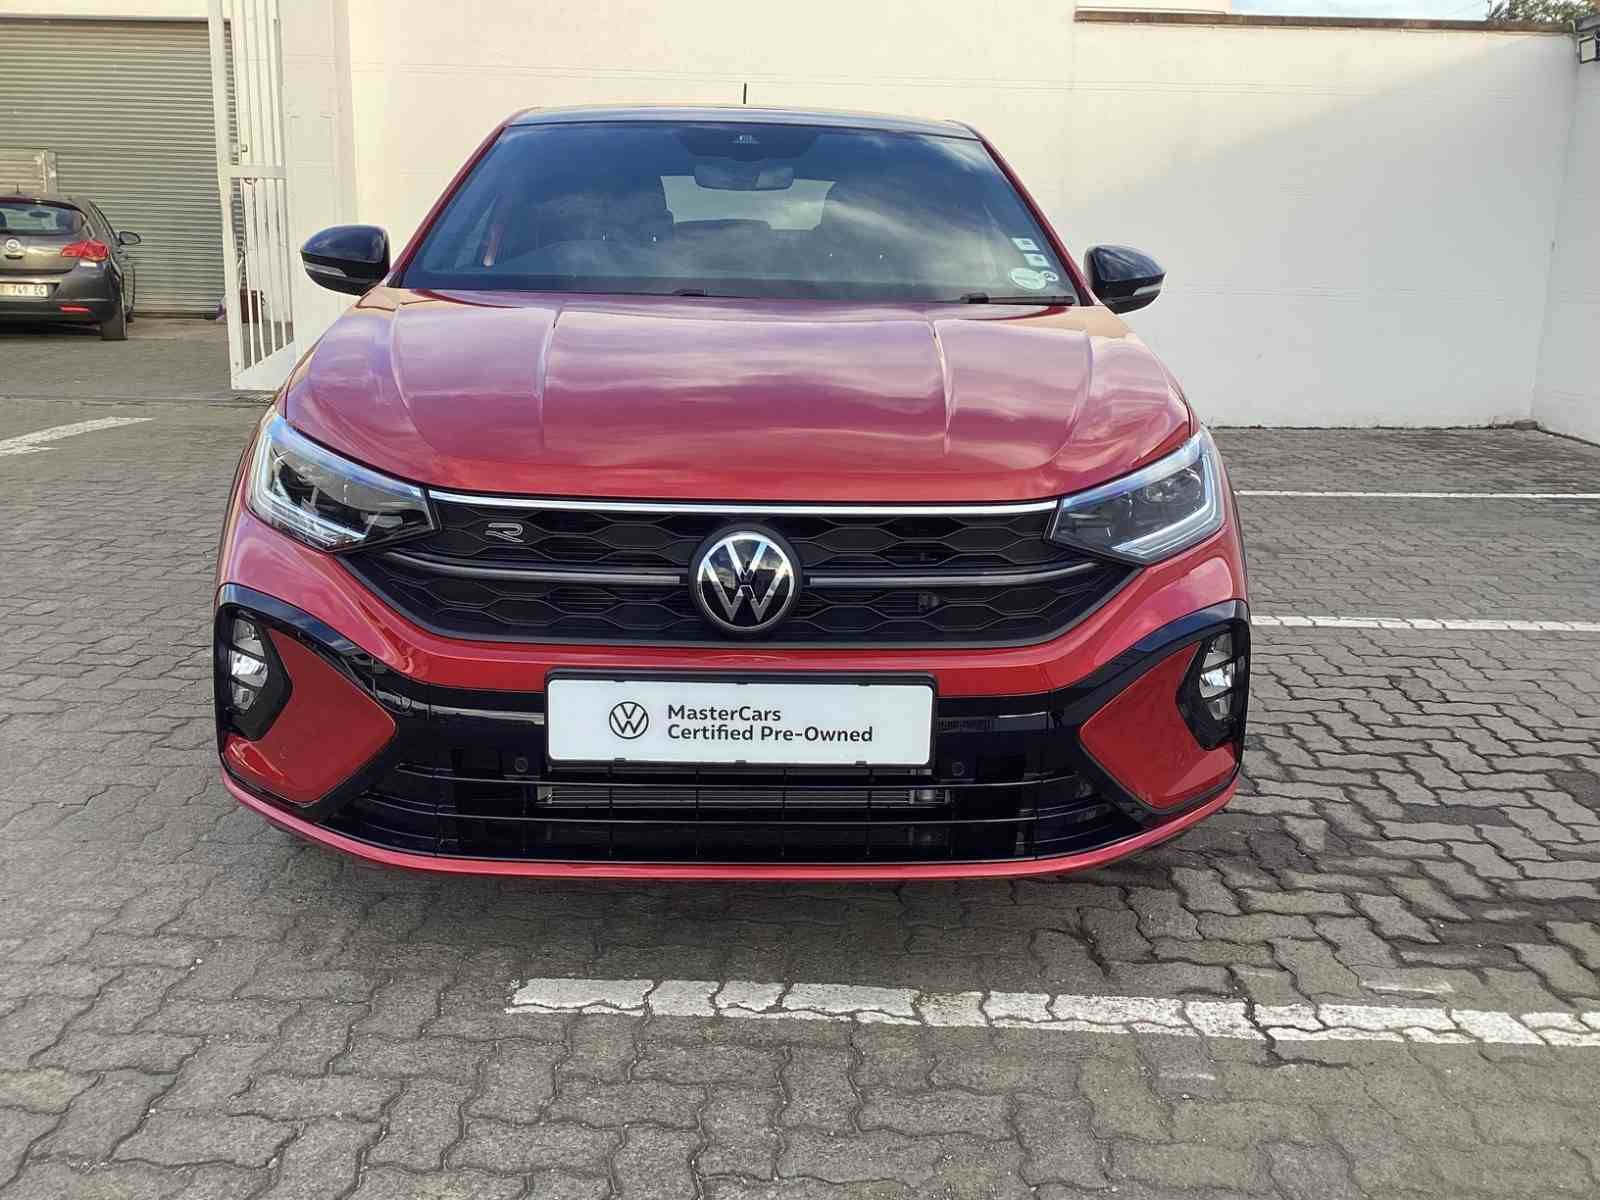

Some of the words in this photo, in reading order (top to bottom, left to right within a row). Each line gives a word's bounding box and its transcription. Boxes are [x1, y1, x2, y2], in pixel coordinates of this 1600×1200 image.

[667, 704, 782, 722] MasterCars
[667, 724, 753, 741] Certified
[760, 726, 873, 743] Pre-Owned
